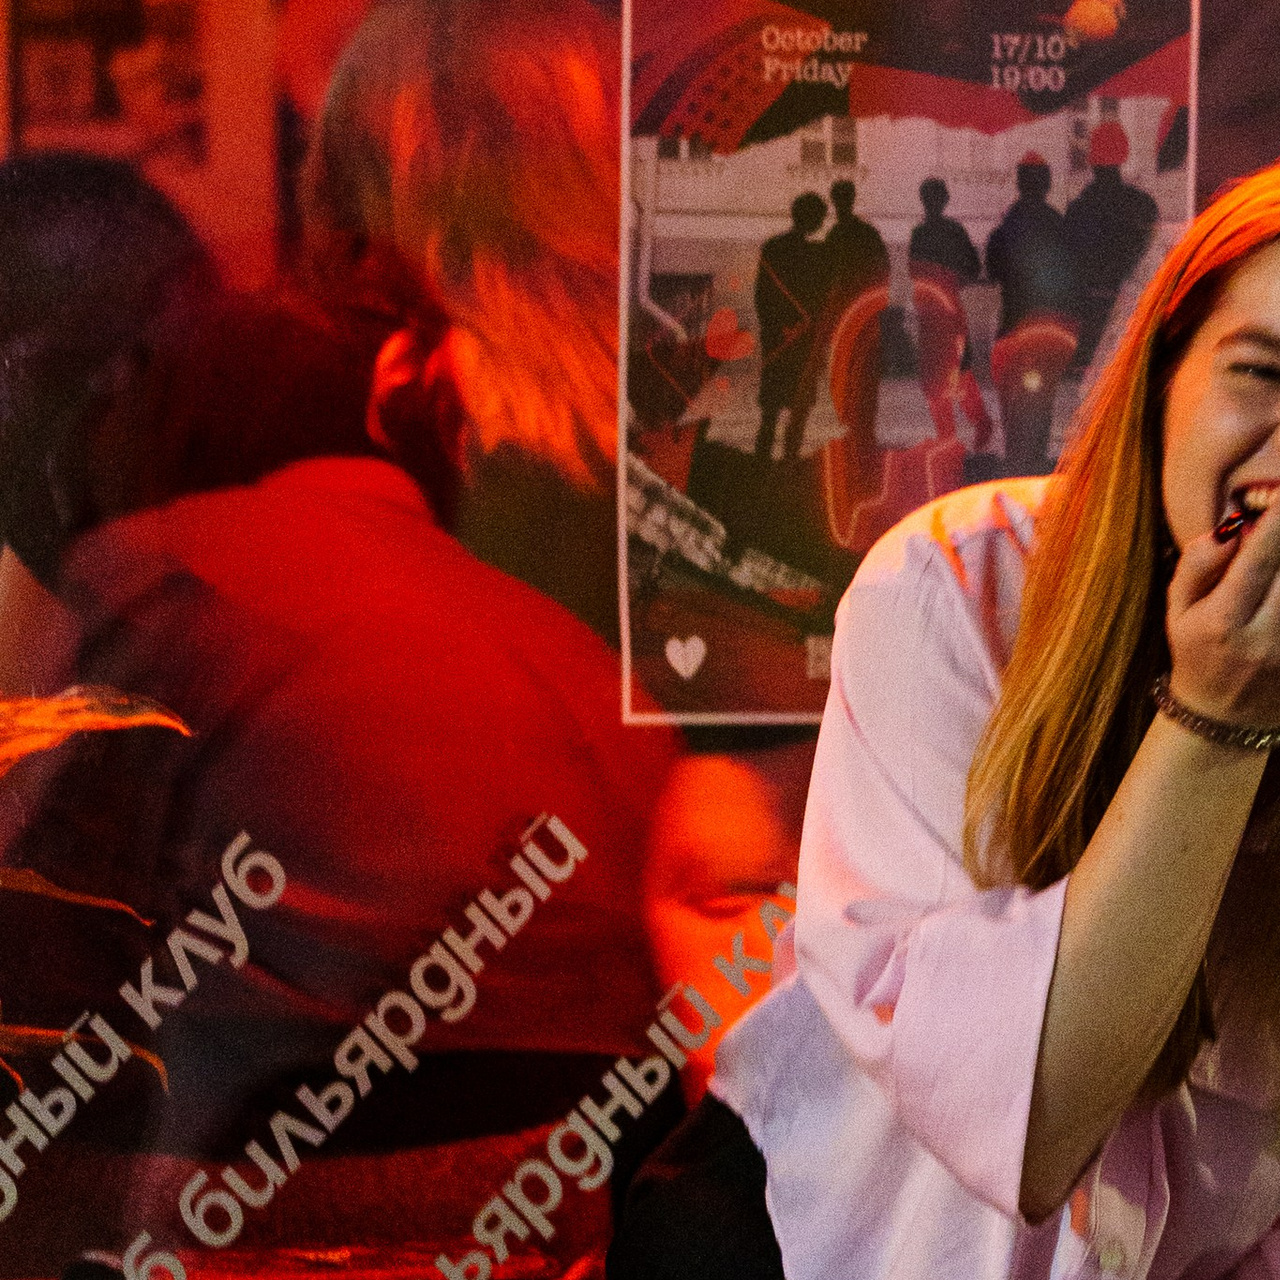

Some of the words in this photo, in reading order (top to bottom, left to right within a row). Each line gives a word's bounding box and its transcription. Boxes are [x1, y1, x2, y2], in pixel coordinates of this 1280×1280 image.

[761, 24, 868, 53] October
[990, 32, 1066, 63] 17/10
[762, 56, 852, 90] Friday
[990, 65, 1066, 92] 19:00
[713, 881, 797, 997] кл
[0, 1009, 133, 1221] ный
[120, 832, 288, 1029] клуб
[179, 811, 589, 1250] бильярдный
